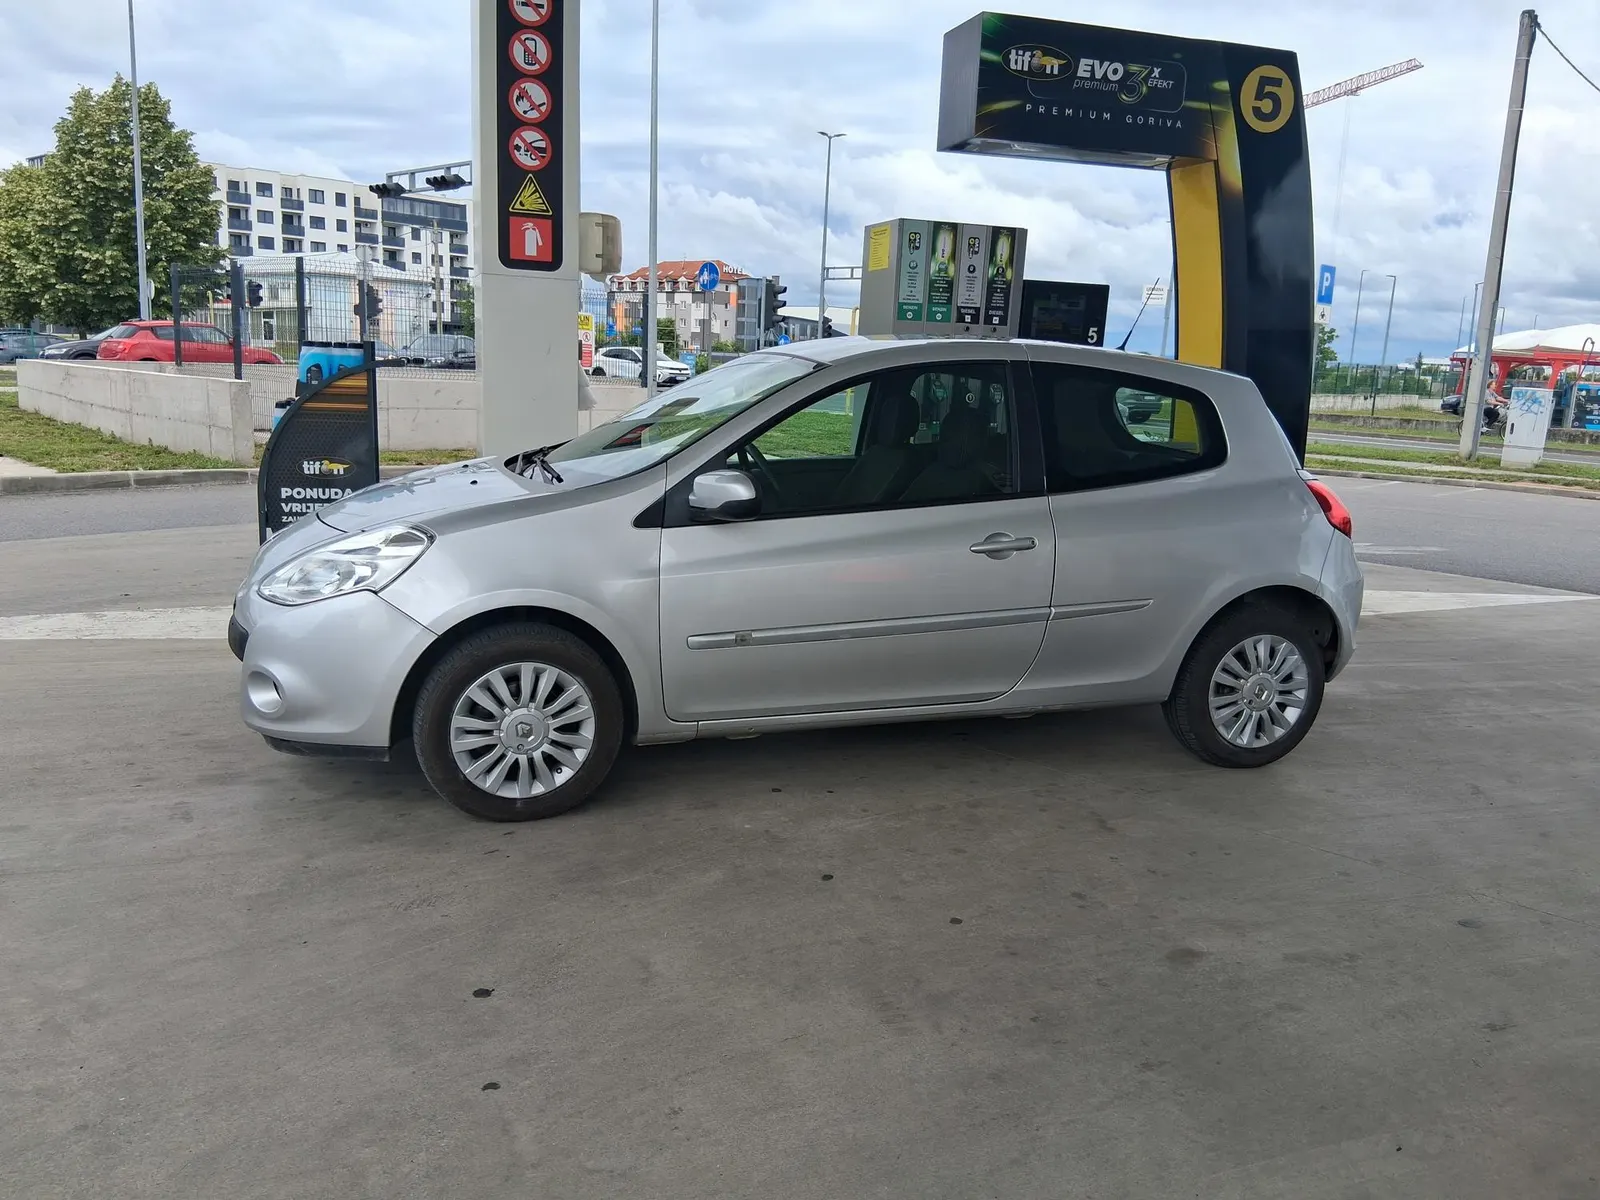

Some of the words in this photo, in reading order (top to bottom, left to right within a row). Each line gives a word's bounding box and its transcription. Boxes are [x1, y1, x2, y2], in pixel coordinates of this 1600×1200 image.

[1009, 49, 1066, 75] tifon
[1077, 58, 1124, 81] EVO
[1072, 79, 1119, 92] premium
[1117, 64, 1151, 104] 3
[1147, 78, 1174, 89] EFEKT
[1252, 75, 1283, 123] 5
[1025, 103, 1112, 121] PREMIUM
[1125, 115, 1183, 129] GORIVA
[1321, 271, 1331, 296] P
[1087, 327, 1098, 343] 5
[302, 460, 350, 475] tifon
